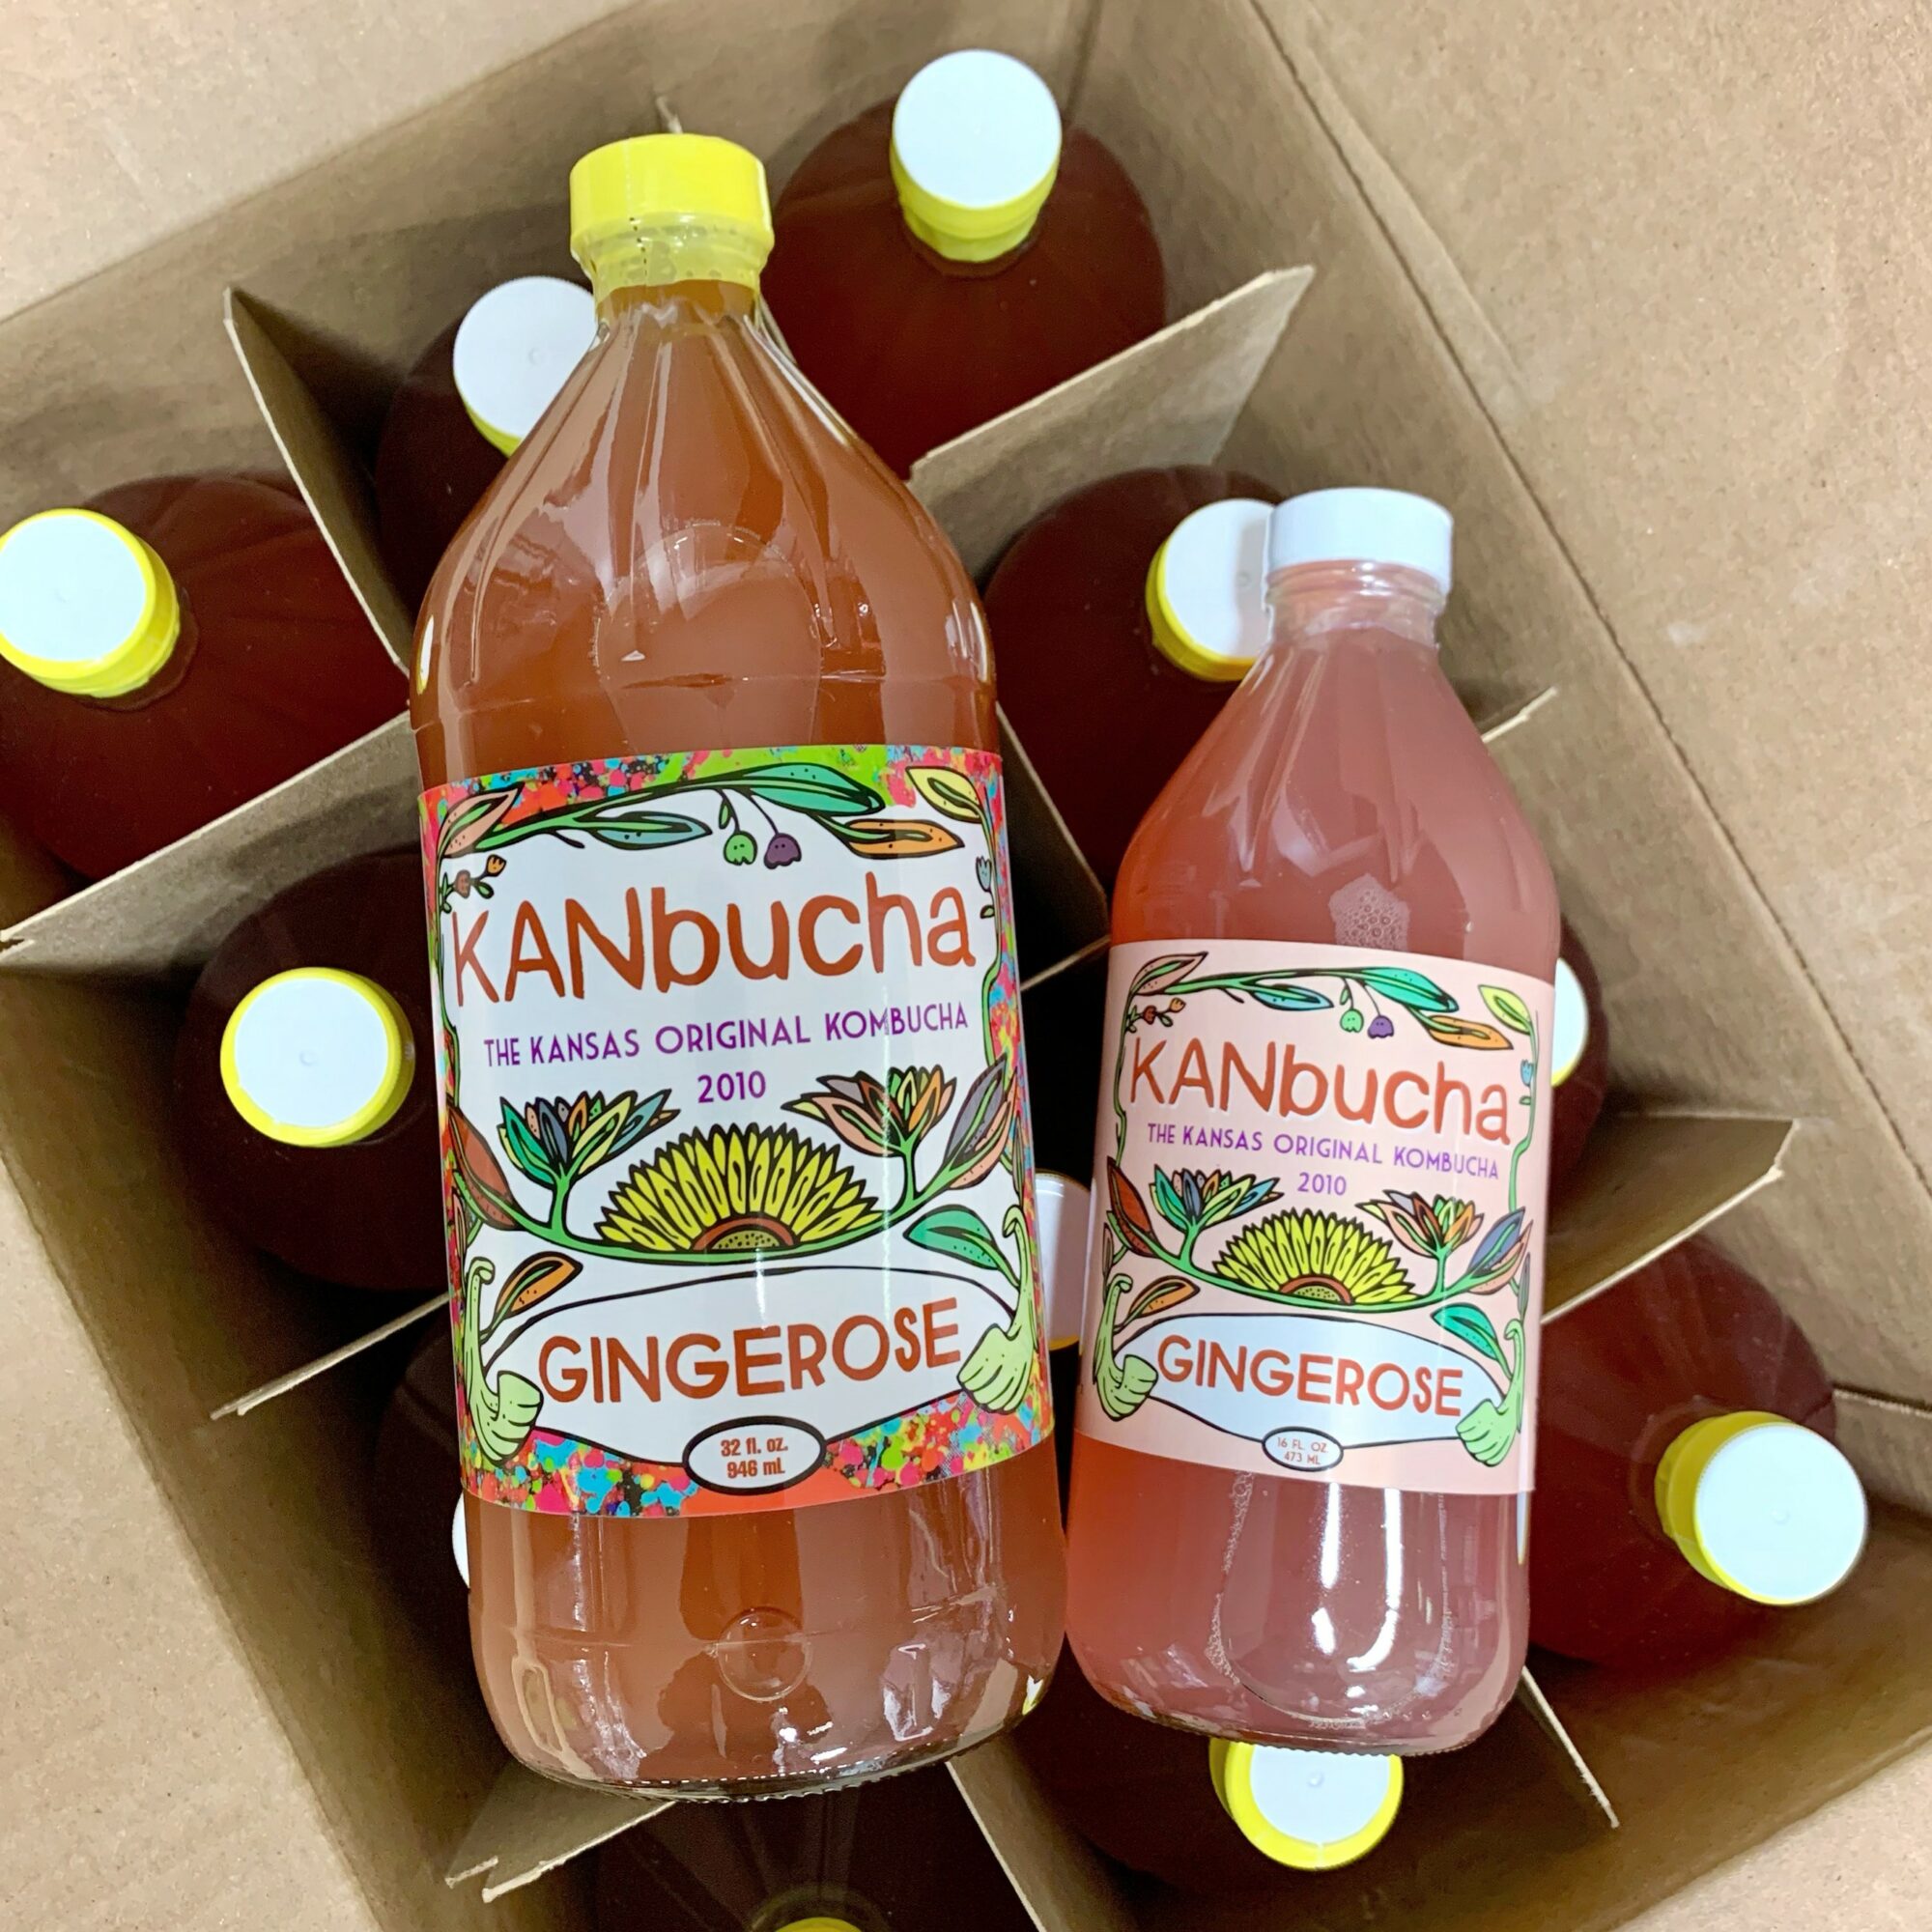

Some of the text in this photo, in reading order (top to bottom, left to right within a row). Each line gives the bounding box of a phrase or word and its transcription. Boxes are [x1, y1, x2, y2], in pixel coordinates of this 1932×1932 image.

[452, 871, 977, 1007] KANbucha
[484, 1002, 968, 1066] THE KANSAS ORIGINAL KOMBUCHA
[696, 1070, 766, 1103] 2010
[1130, 1037, 1512, 1146] KANbucha
[1148, 1122, 1499, 1179] THE KANSAS ORIGINAL KOMBUCHA
[1297, 1172, 1348, 1197] 2010
[538, 1296, 961, 1404] GINGEROSE
[1157, 1334, 1463, 1417] GINGEROSE
[720, 1438, 741, 1457] 32
[1277, 1436, 1288, 1448] 16
[1284, 1451, 1321, 1465] 473 ML
[726, 1460, 757, 1479] 946
